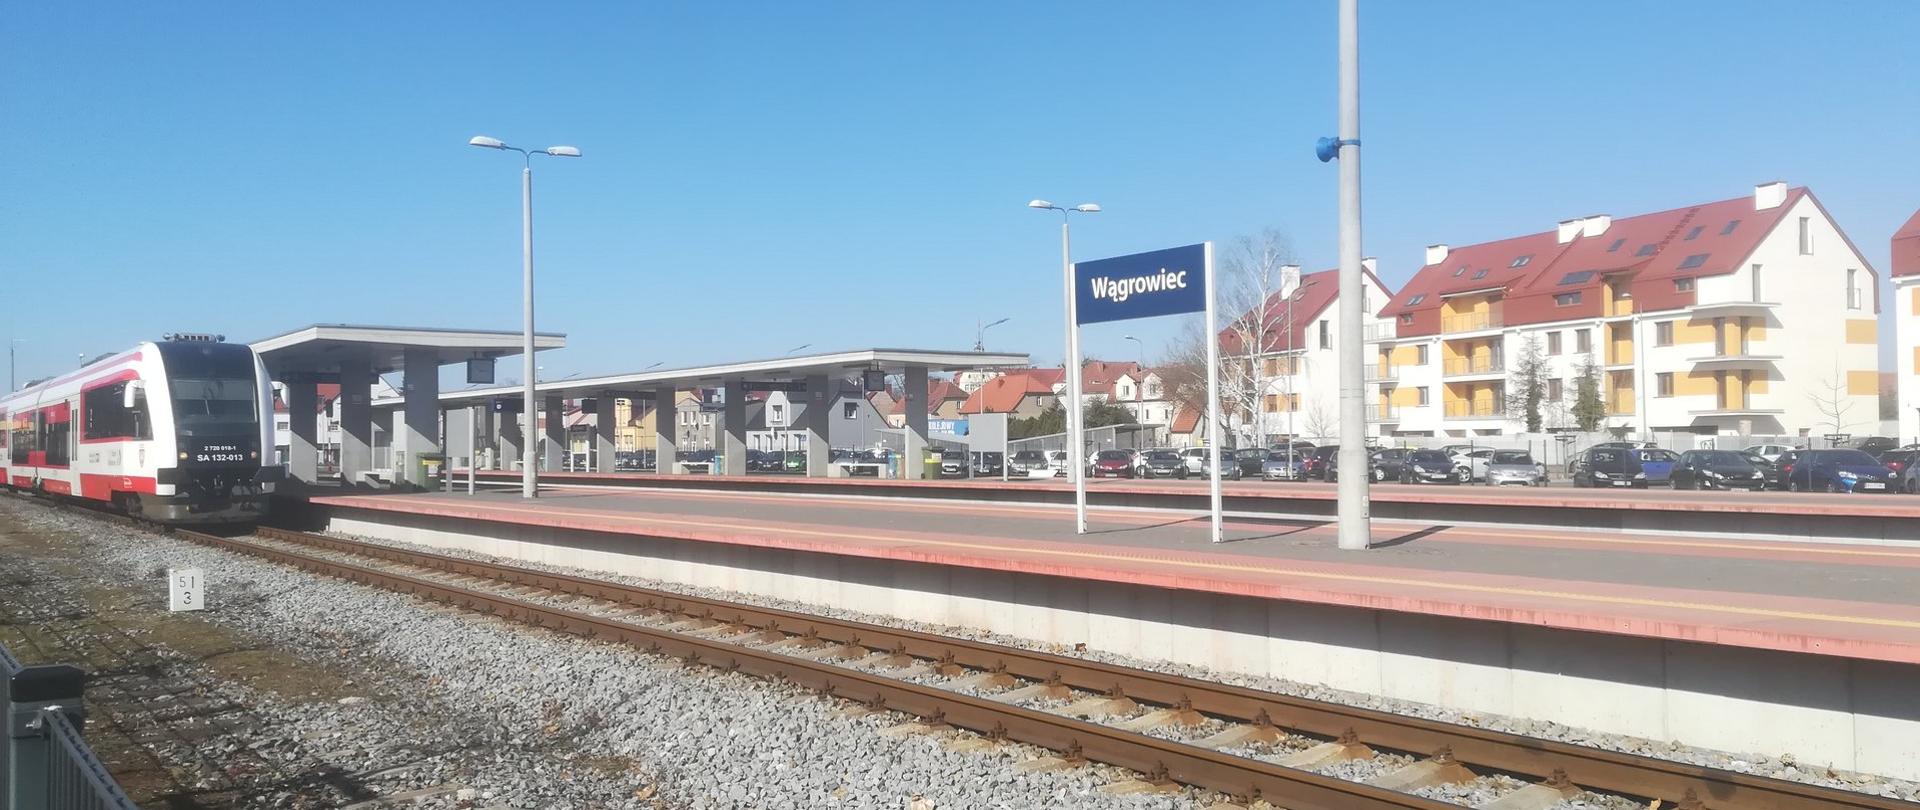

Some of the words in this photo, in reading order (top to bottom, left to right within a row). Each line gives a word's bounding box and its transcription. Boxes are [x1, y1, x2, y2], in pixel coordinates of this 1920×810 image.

[1091, 267, 1187, 302] Wągrowiec
[197, 454, 210, 462] SA
[183, 591, 192, 605] 3
